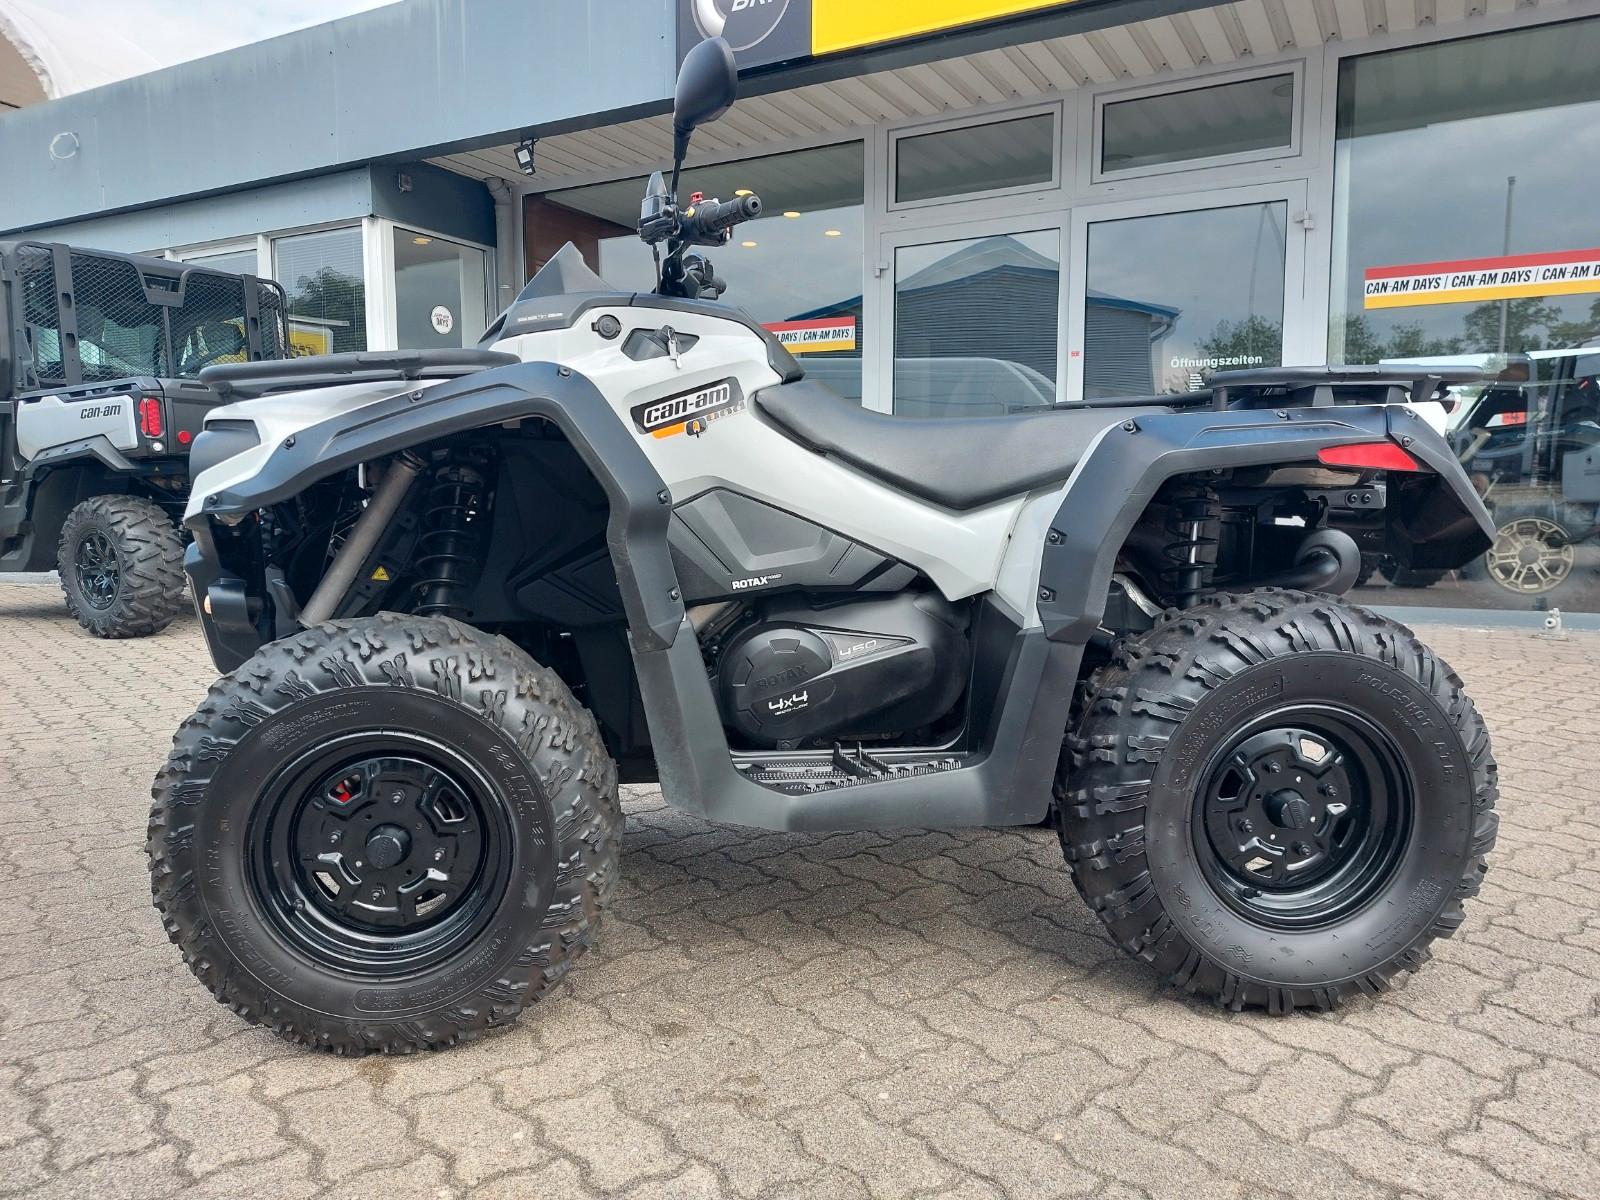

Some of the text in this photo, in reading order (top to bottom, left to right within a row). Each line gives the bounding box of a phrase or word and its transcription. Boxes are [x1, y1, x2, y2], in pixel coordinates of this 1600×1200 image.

[1366, 280, 1409, 295] CAN-AM
[1412, 277, 1442, 291] DAYS
[1451, 272, 1498, 288] CAN-AM
[1500, 269, 1532, 284] DAYS
[1542, 265, 1591, 280] CAN-AM
[781, 332, 798, 343] DAYS
[803, 330, 831, 341] CAN-AM
[832, 328, 850, 339] DAYS
[1170, 355, 1263, 369] Öffnungszeiten
[80, 404, 121, 419] can-am
[645, 385, 728, 424] can-am
[731, 576, 768, 590] ROTAX
[768, 690, 808, 710] 4x4
